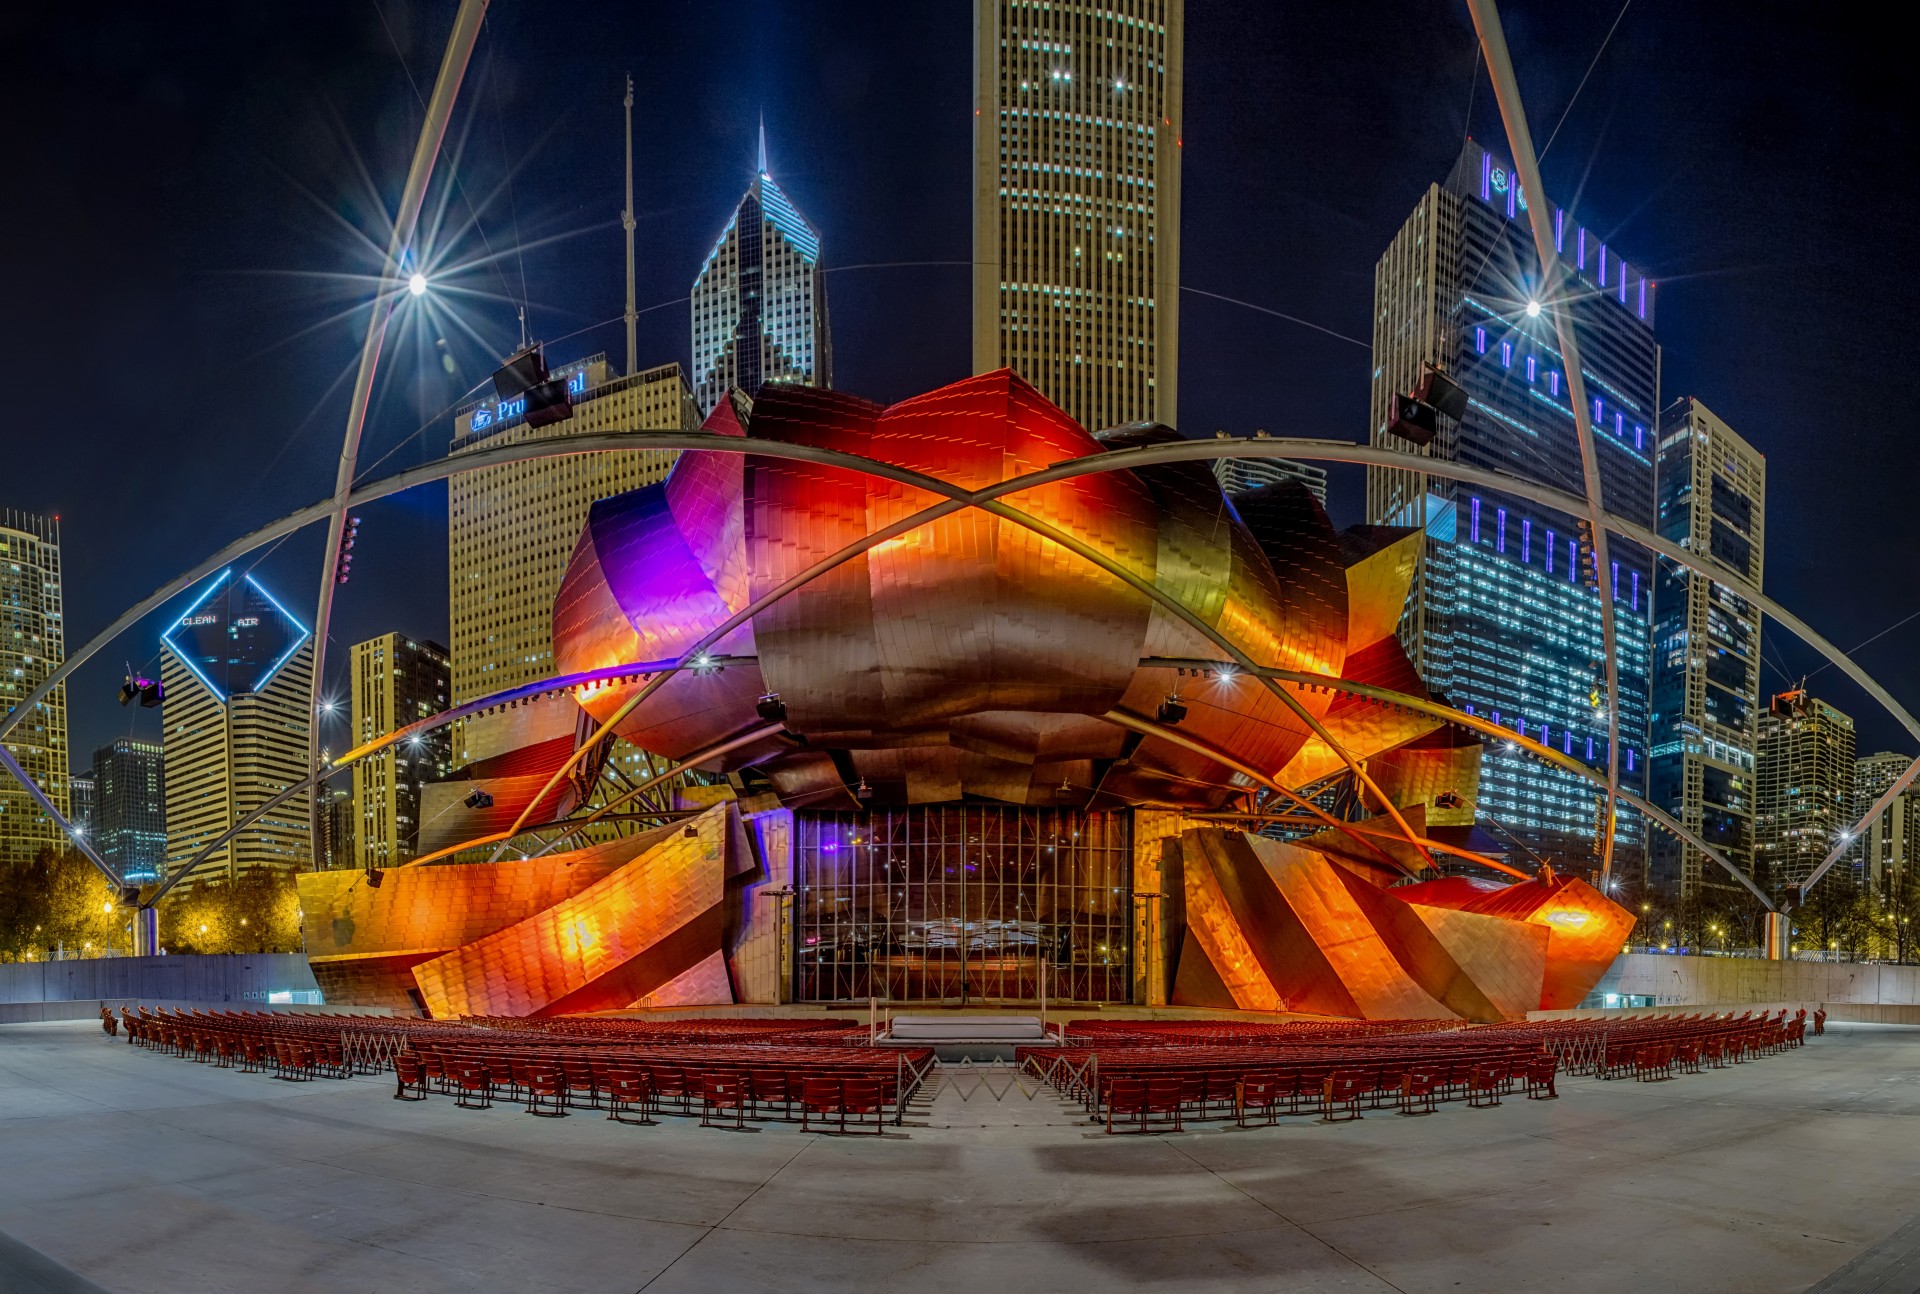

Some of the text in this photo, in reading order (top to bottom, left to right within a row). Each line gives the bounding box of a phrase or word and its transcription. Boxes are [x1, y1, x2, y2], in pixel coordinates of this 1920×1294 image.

[496, 372, 585, 421] Prual
[182, 615, 259, 627] CLEAN AIR
